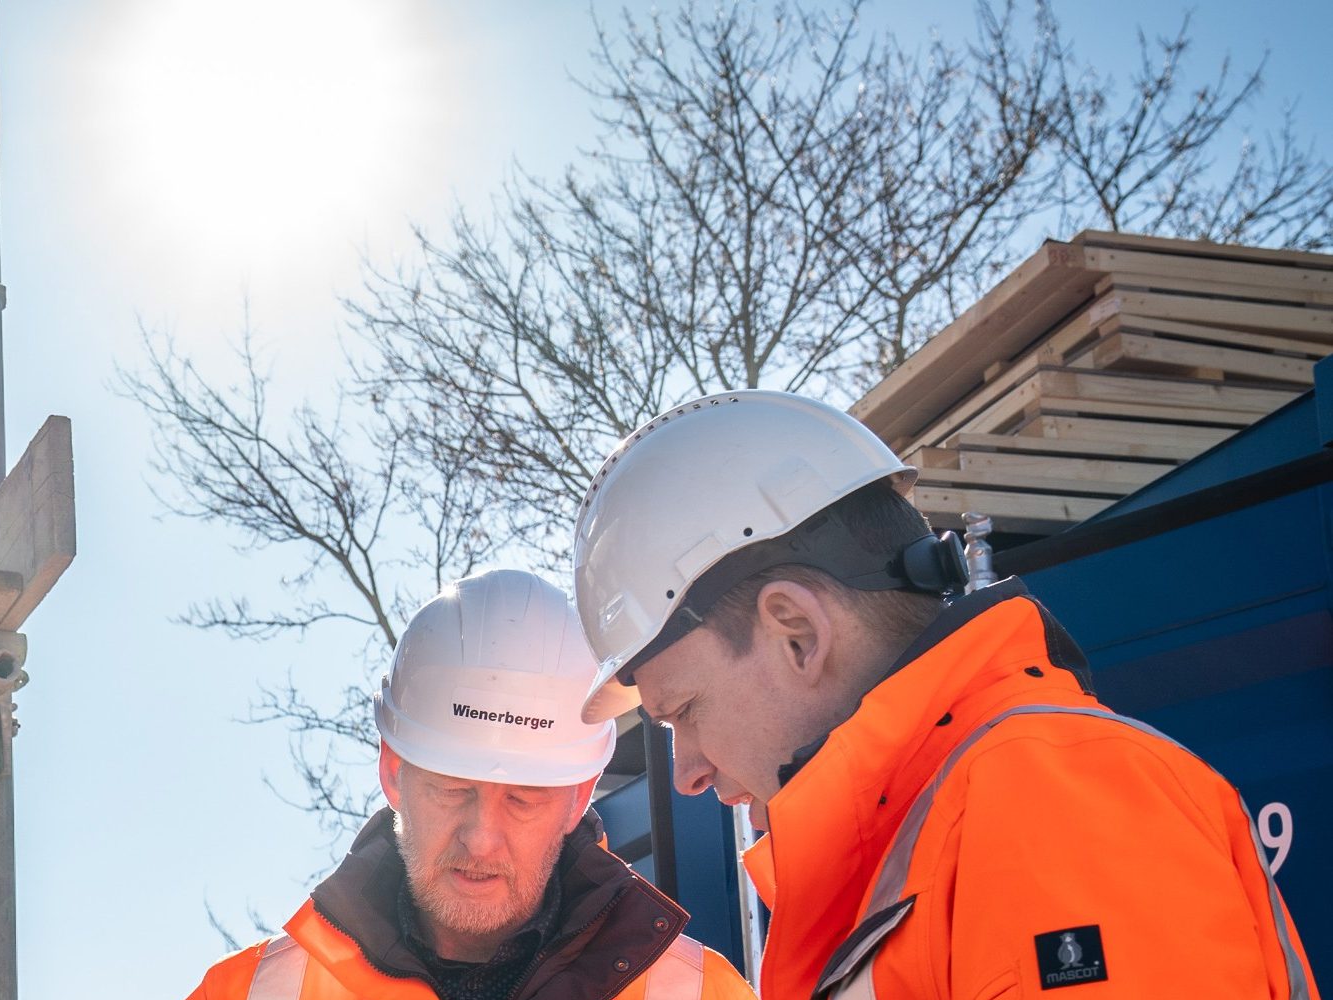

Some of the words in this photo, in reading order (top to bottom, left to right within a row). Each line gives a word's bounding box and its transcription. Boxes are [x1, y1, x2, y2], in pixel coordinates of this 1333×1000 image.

[452, 702, 555, 730] Wienerberger
[1257, 801, 1294, 877] 9
[1046, 966, 1099, 984] MASCOT
